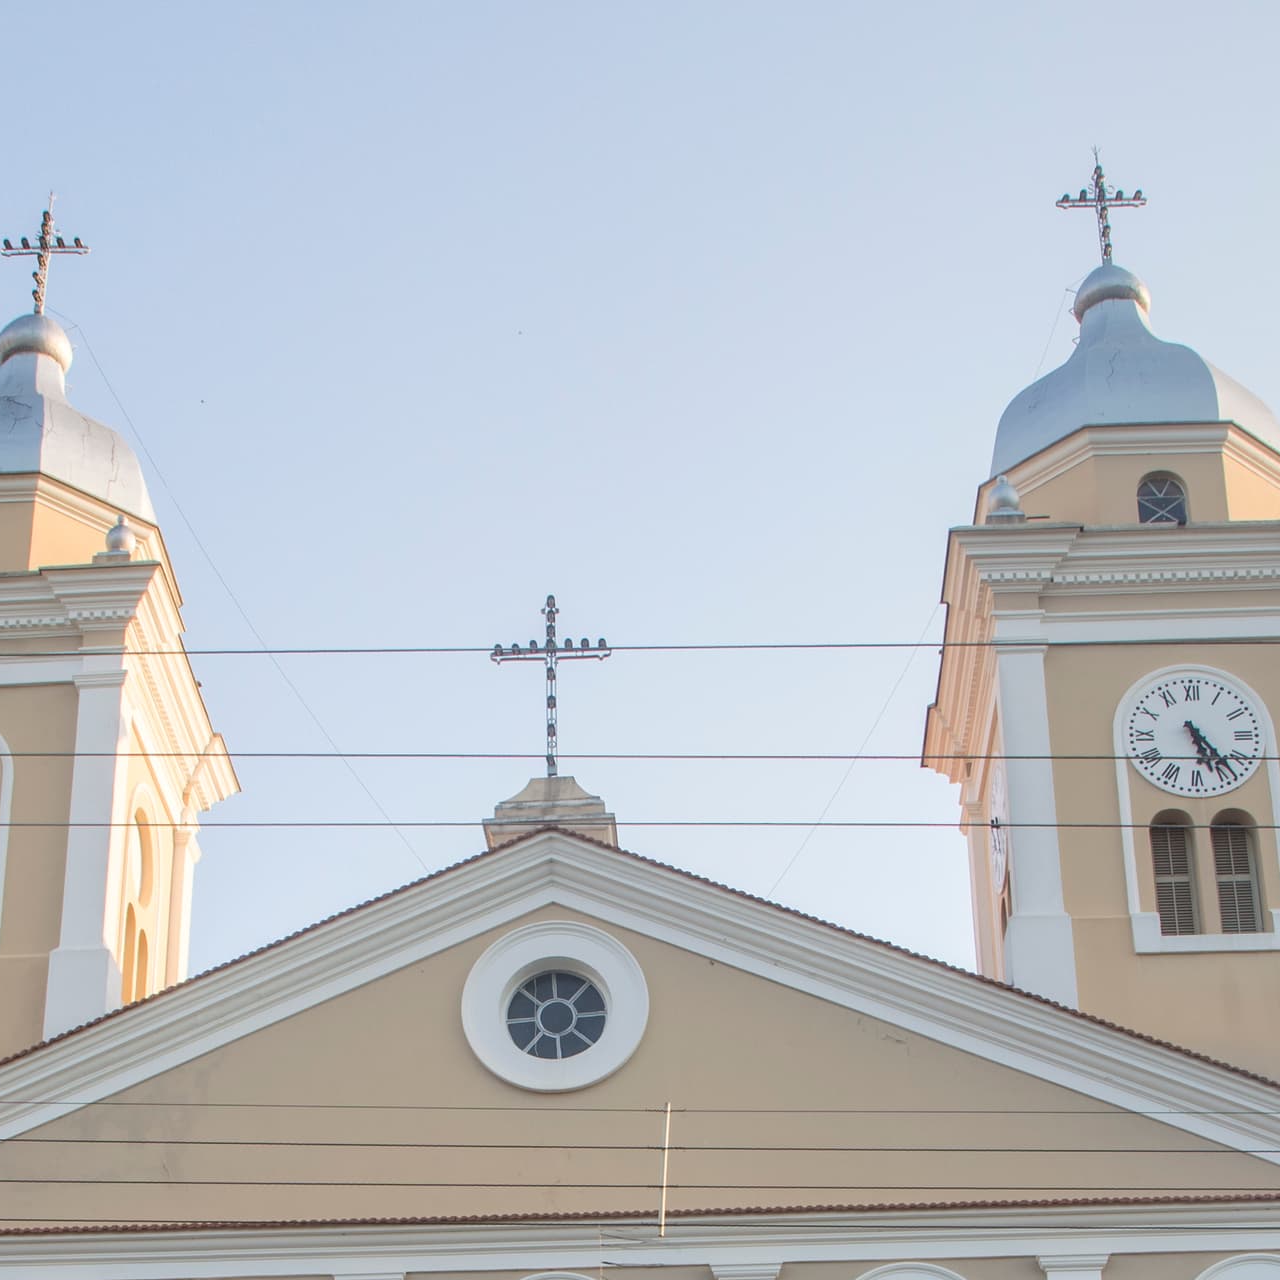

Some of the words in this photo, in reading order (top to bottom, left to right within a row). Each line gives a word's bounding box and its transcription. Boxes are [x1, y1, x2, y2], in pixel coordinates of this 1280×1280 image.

[1158, 689, 1177, 708] XI
[1183, 685, 1200, 702] XII
[1210, 691, 1221, 706] I
[1140, 707, 1160, 721] X
[1226, 707, 1245, 721] II
[1135, 729, 1155, 742] IX
[1233, 730, 1254, 741] III
[1140, 747, 1162, 769] VIII
[1161, 762, 1180, 784] VII
[1191, 769, 1204, 787] VI
